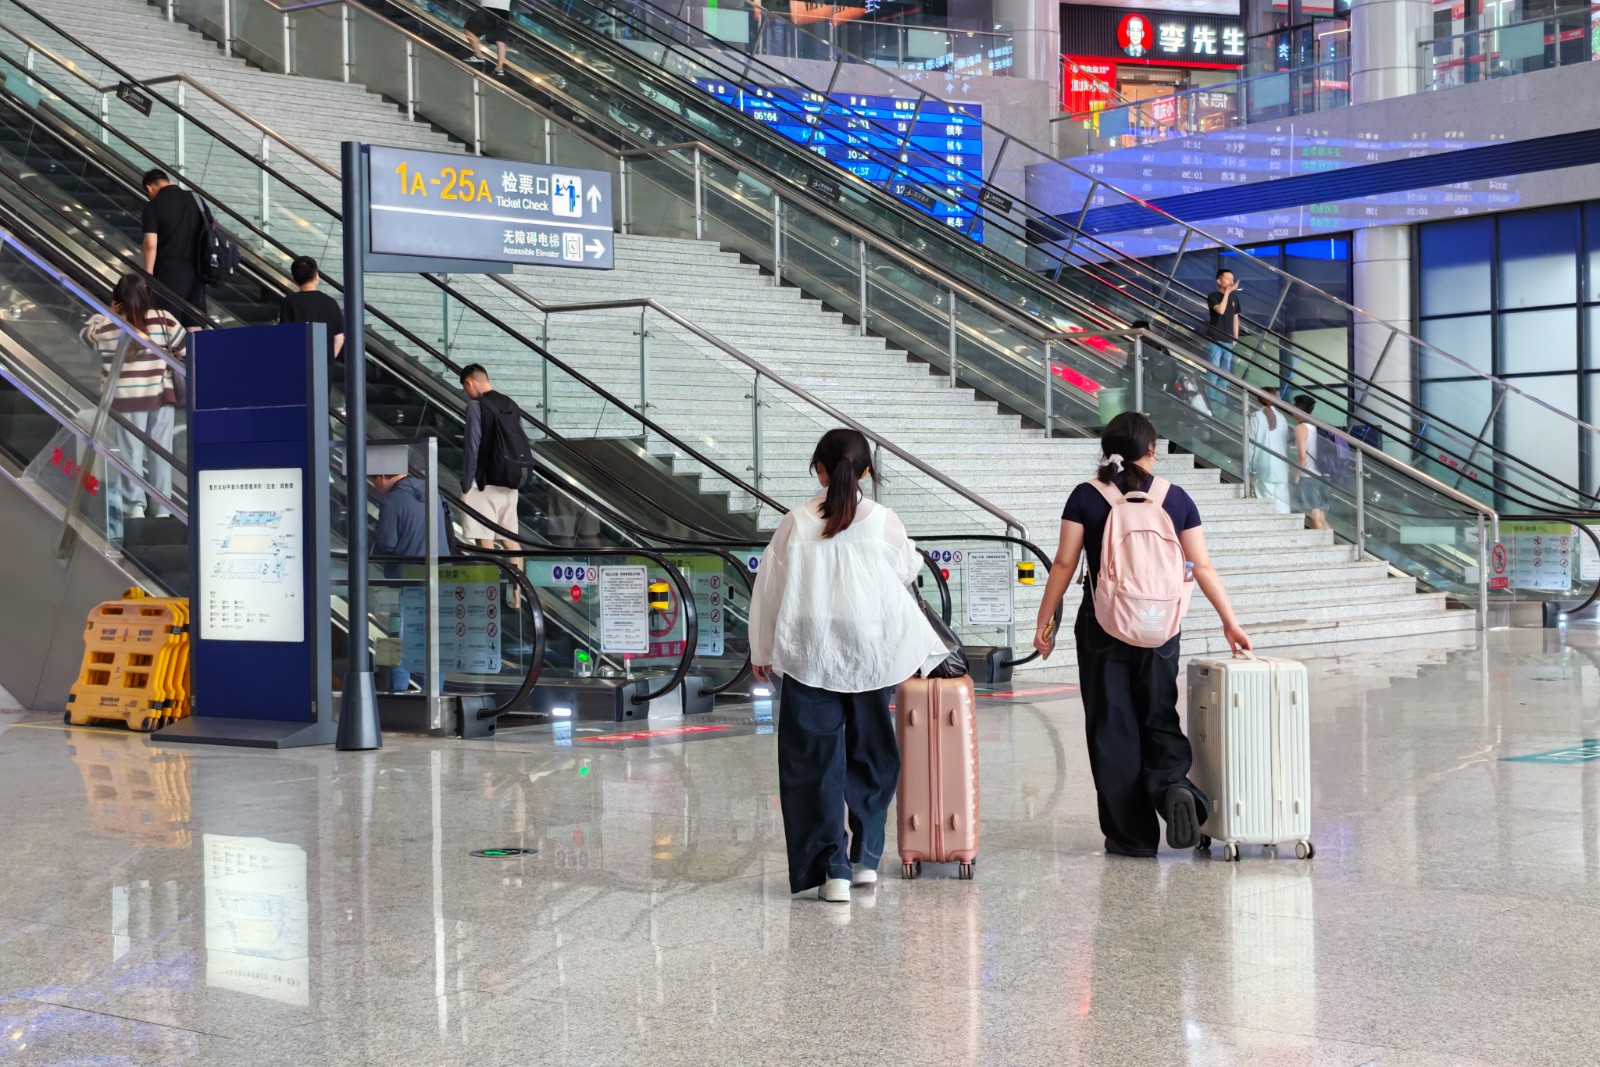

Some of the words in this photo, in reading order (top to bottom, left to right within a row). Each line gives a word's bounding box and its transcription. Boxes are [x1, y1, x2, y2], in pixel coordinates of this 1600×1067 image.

[1160, 23, 1245, 56] 李先生
[1153, 103, 1179, 119] 重庆小
[395, 162, 493, 203] 1A-25A
[501, 171, 549, 196] 检票口
[496, 196, 521, 209] Ticket
[522, 198, 549, 212] Check
[503, 230, 560, 248] 无障碍电梯
[503, 246, 535, 256] Accessible
[535, 248, 560, 258] Elevator
